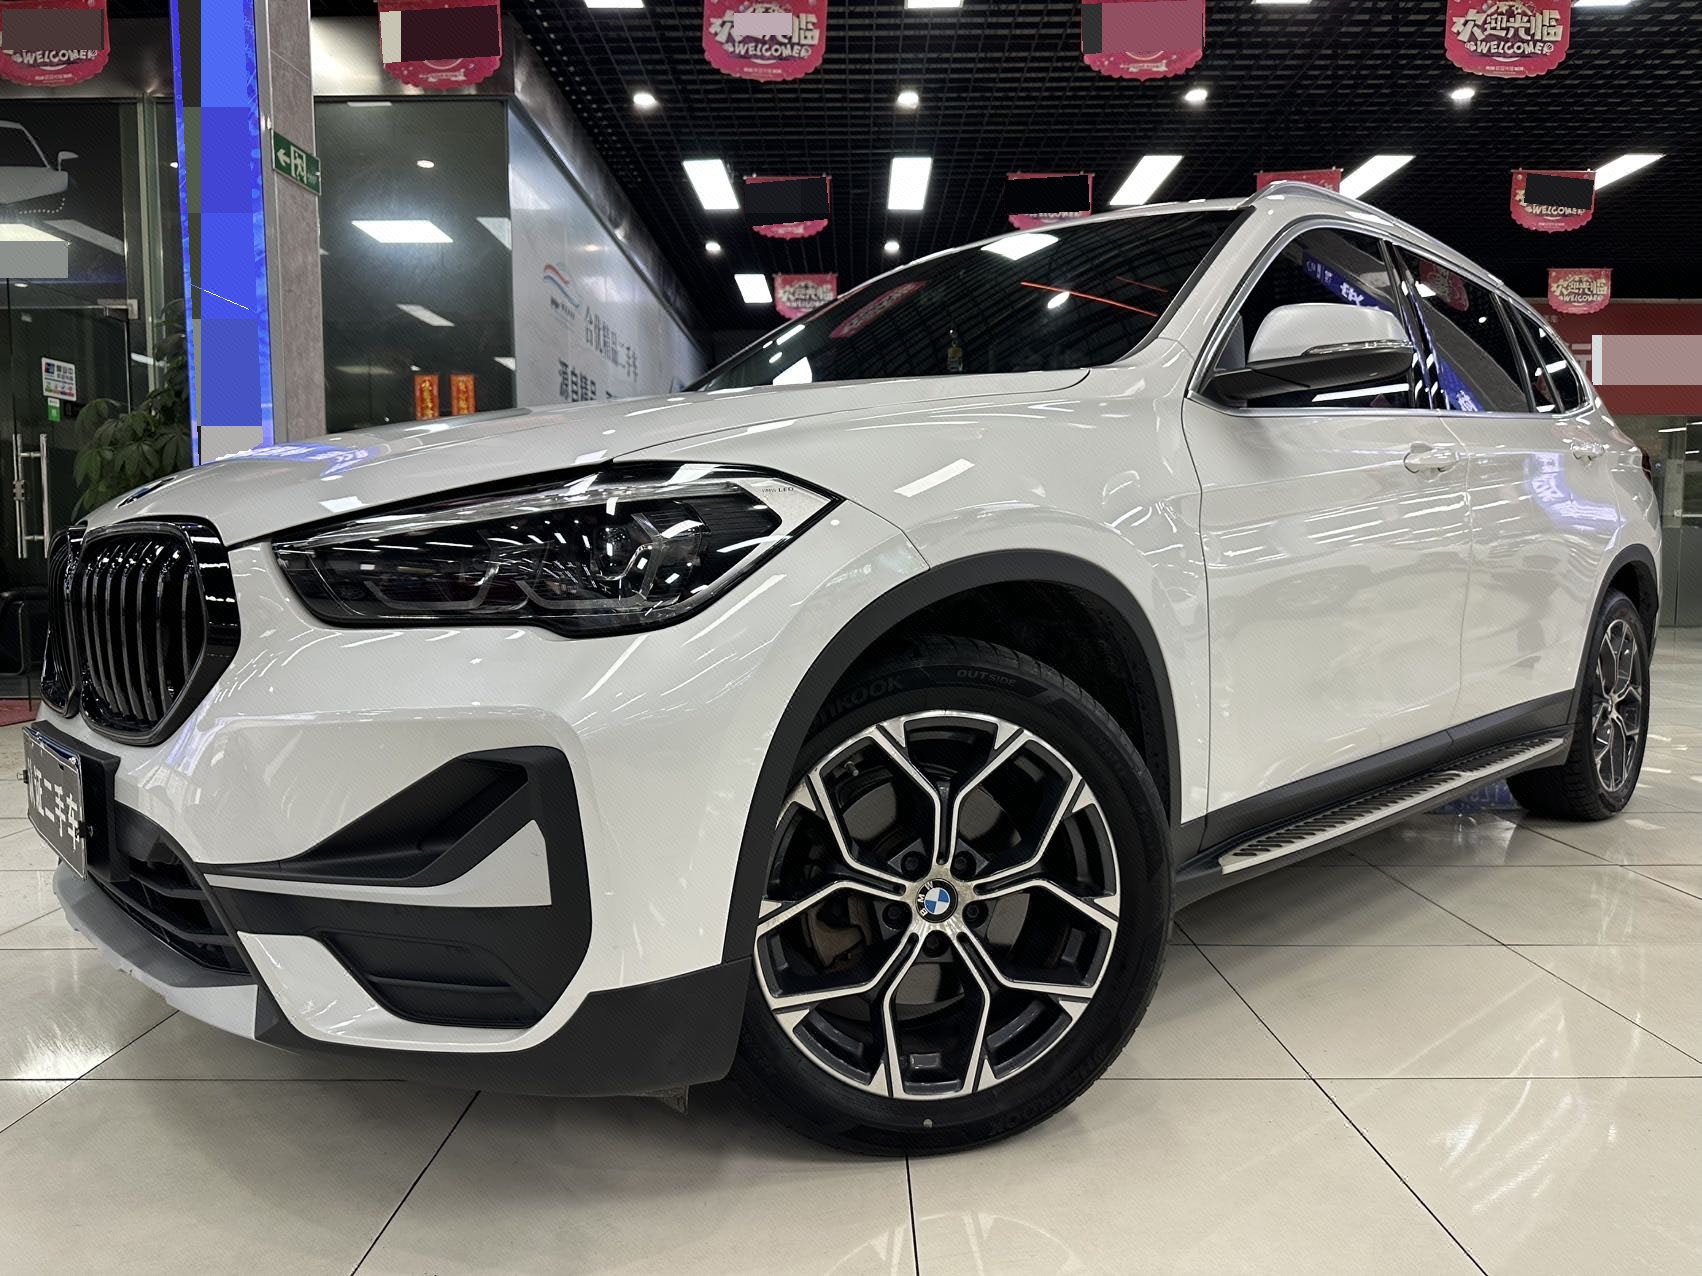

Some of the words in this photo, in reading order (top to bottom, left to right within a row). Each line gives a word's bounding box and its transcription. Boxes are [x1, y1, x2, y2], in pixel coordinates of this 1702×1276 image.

[1451, 9, 1563, 42] 欢迎光临
[1476, 40, 1544, 55] WELCOME
[957, 669, 1017, 688] OUTSIDE
